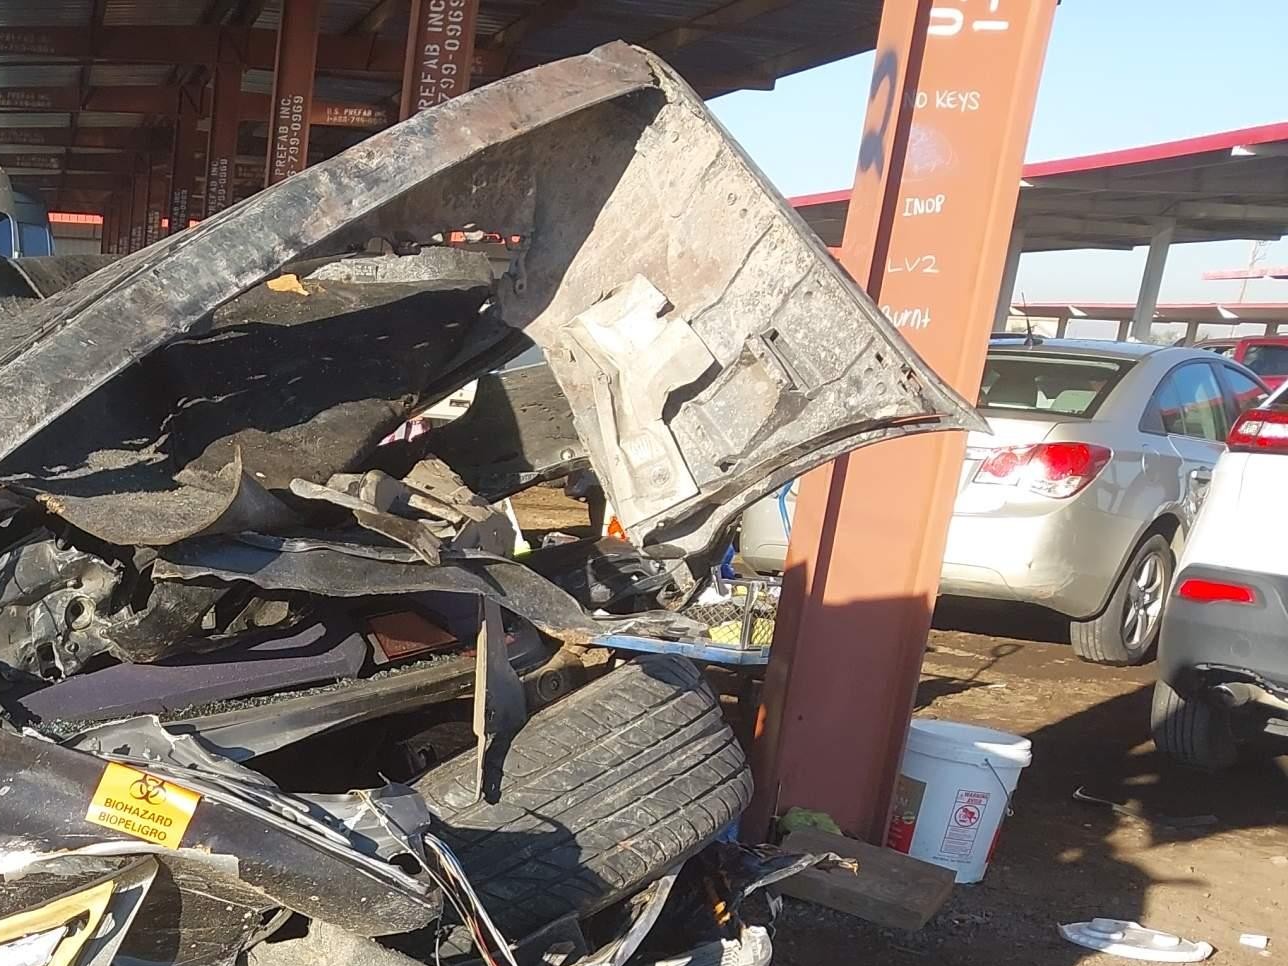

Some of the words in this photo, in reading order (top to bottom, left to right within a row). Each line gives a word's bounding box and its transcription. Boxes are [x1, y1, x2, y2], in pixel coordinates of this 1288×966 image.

[935, 90, 981, 112] KEYS
[275, 126, 289, 176] PREFAB
[887, 255, 941, 273] LV2
[98, 811, 167, 841] BIOPELIGRO
[103, 798, 173, 828] BIOHAZARD
